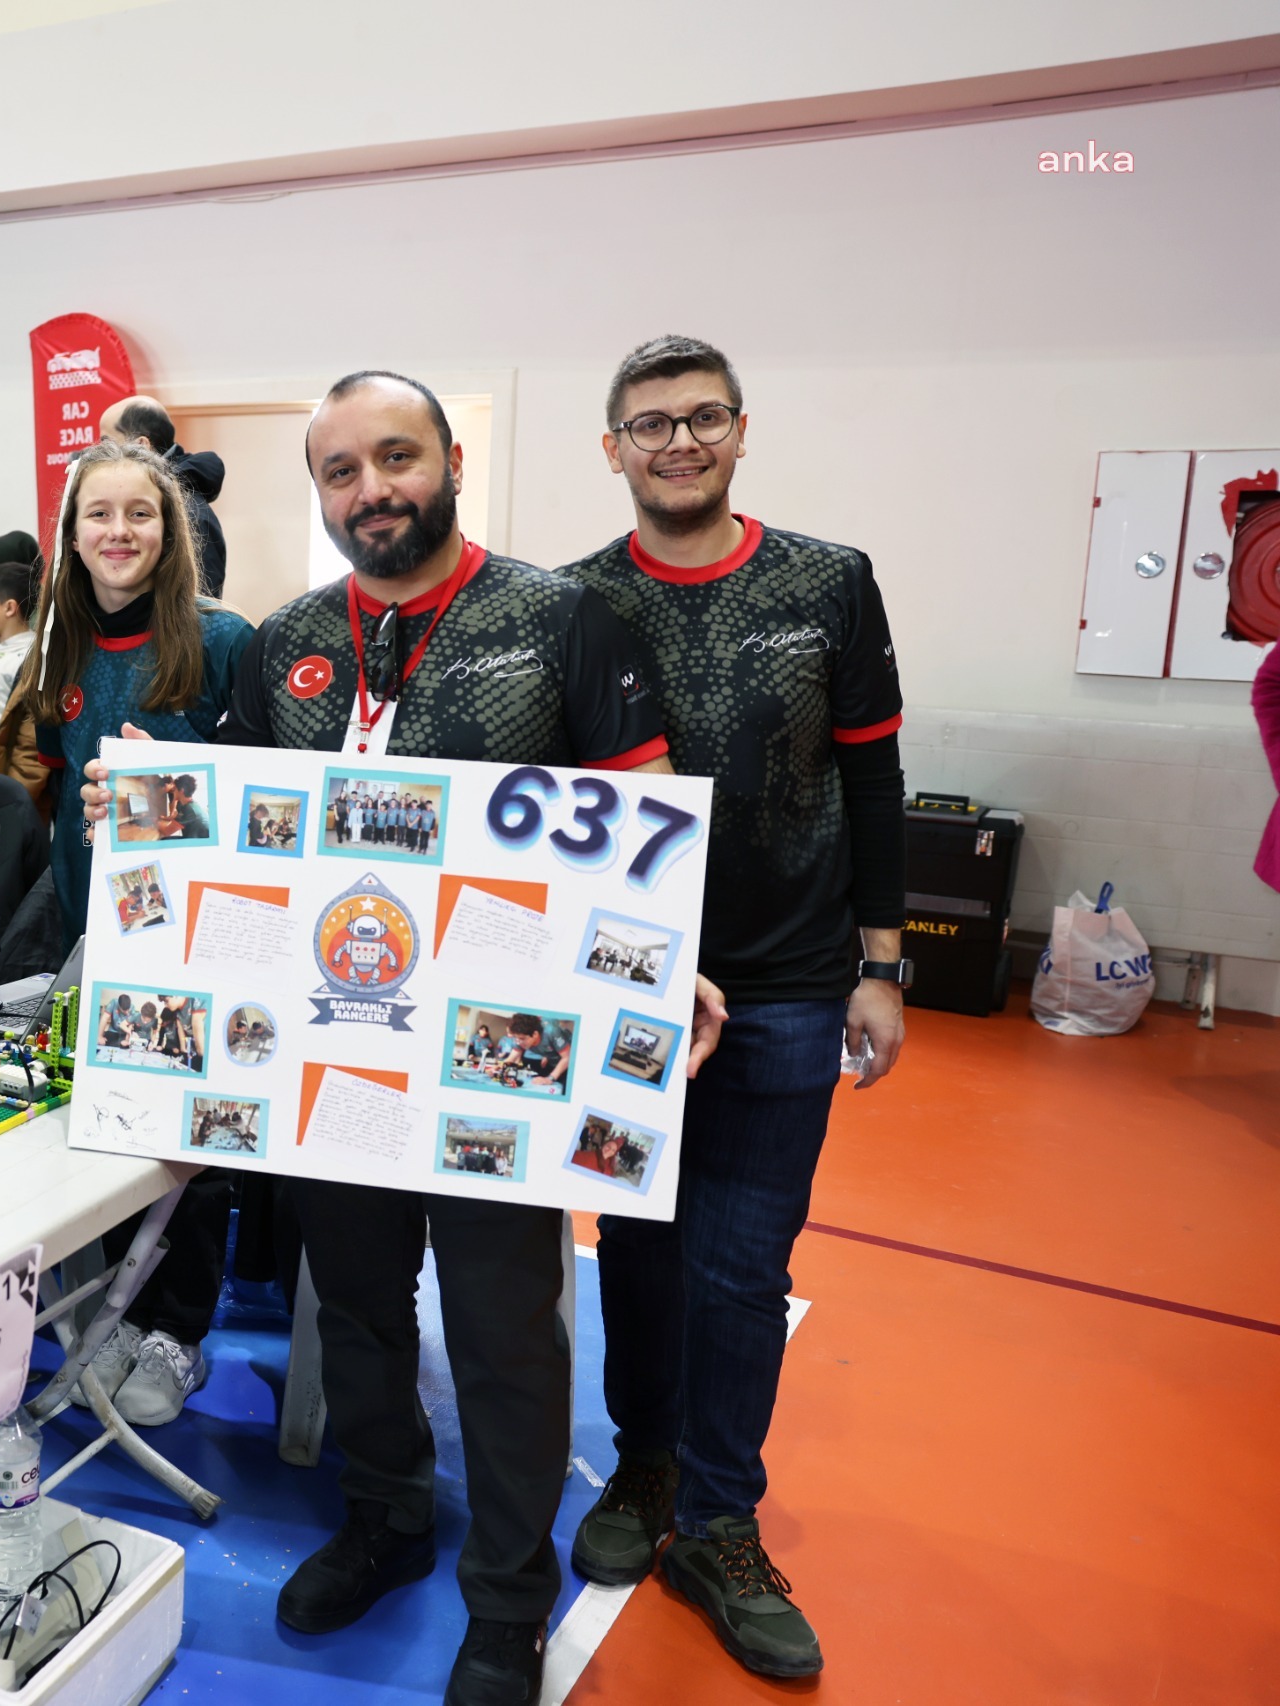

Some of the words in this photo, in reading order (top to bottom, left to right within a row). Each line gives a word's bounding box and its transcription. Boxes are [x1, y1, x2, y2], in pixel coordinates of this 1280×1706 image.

[485, 766, 704, 894] 637
[329, 1000, 393, 1014] BAYRAKLI
[333, 1009, 390, 1023] RANGERS
